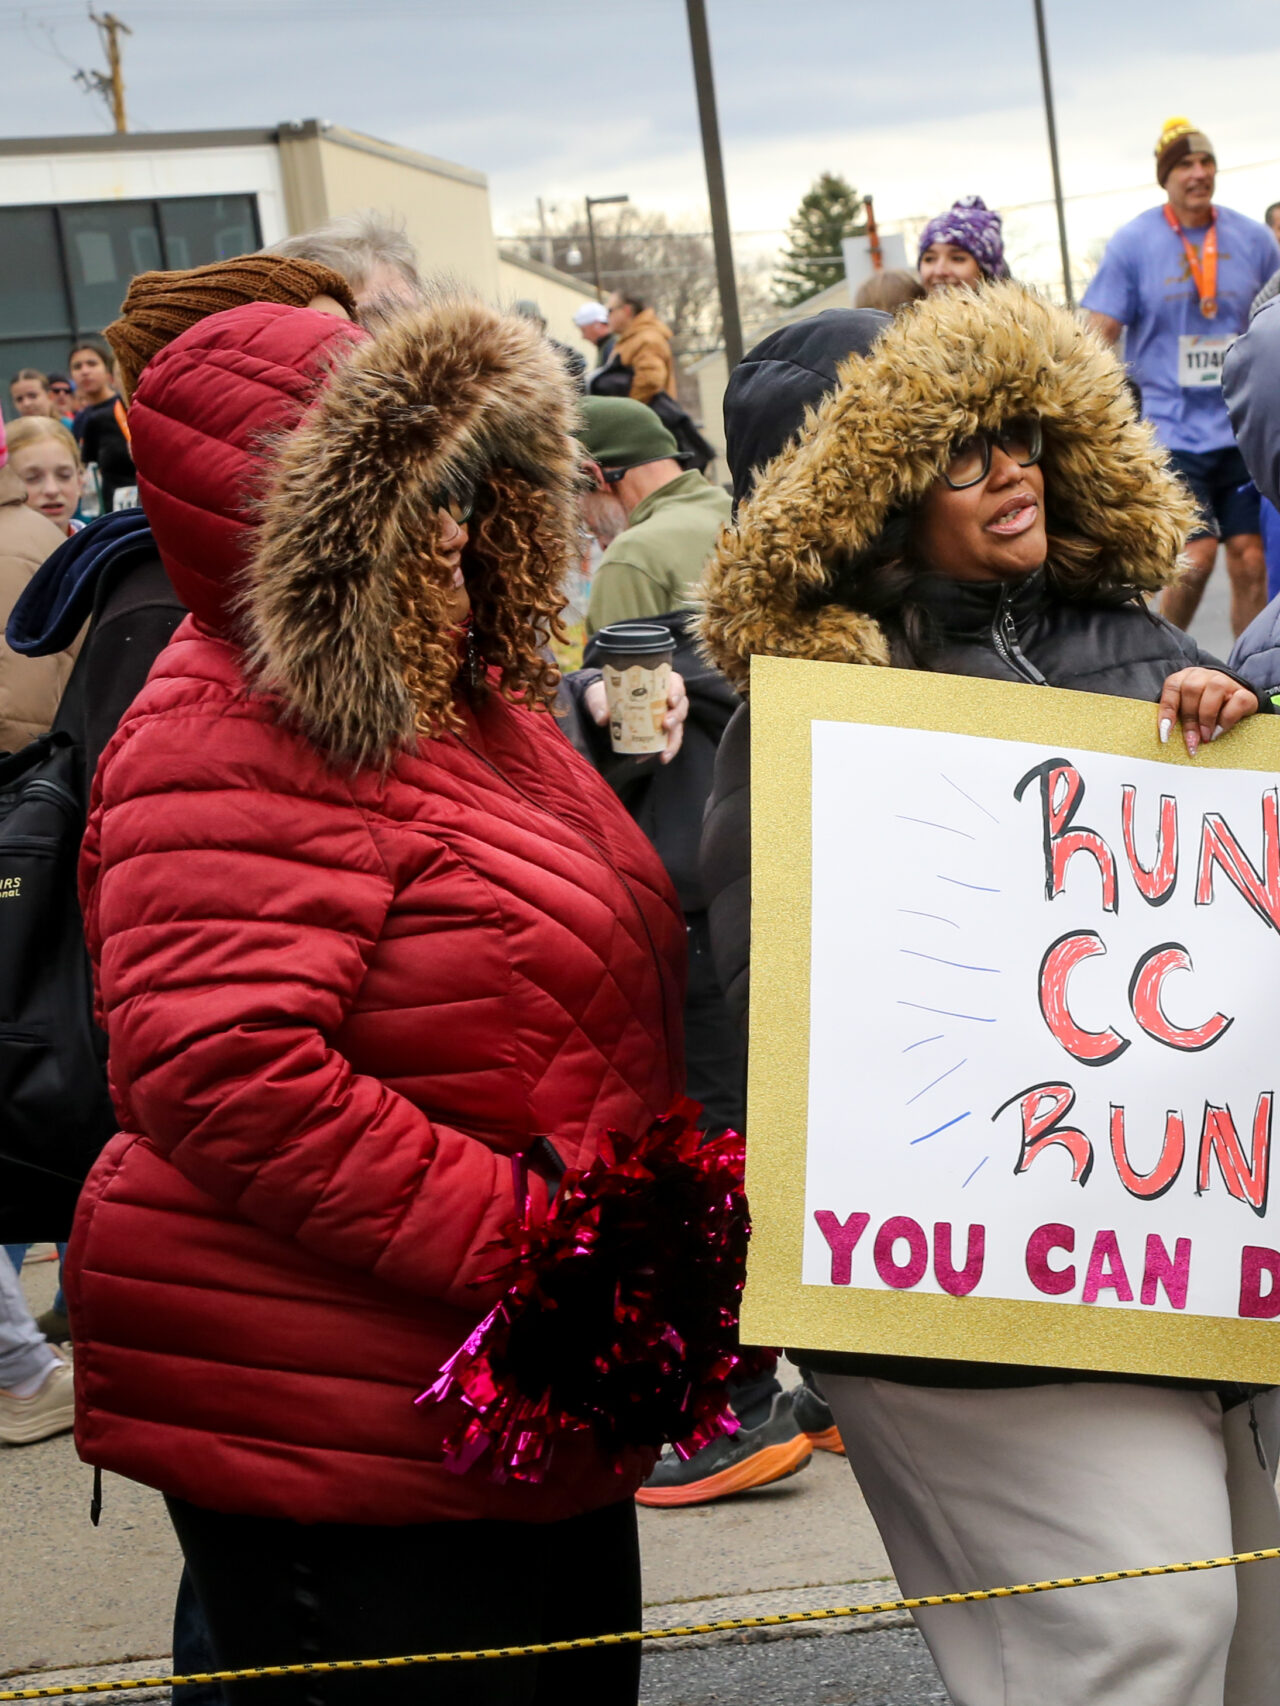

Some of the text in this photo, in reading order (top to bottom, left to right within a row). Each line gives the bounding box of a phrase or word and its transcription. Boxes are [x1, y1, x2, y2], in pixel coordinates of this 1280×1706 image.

[1187, 351, 1225, 368] 1174
[1038, 929, 1234, 1066] CC
[991, 1081, 1274, 1218] RUN
[814, 1210, 986, 1297] YOU
[1025, 1222, 1192, 1309] CAN
